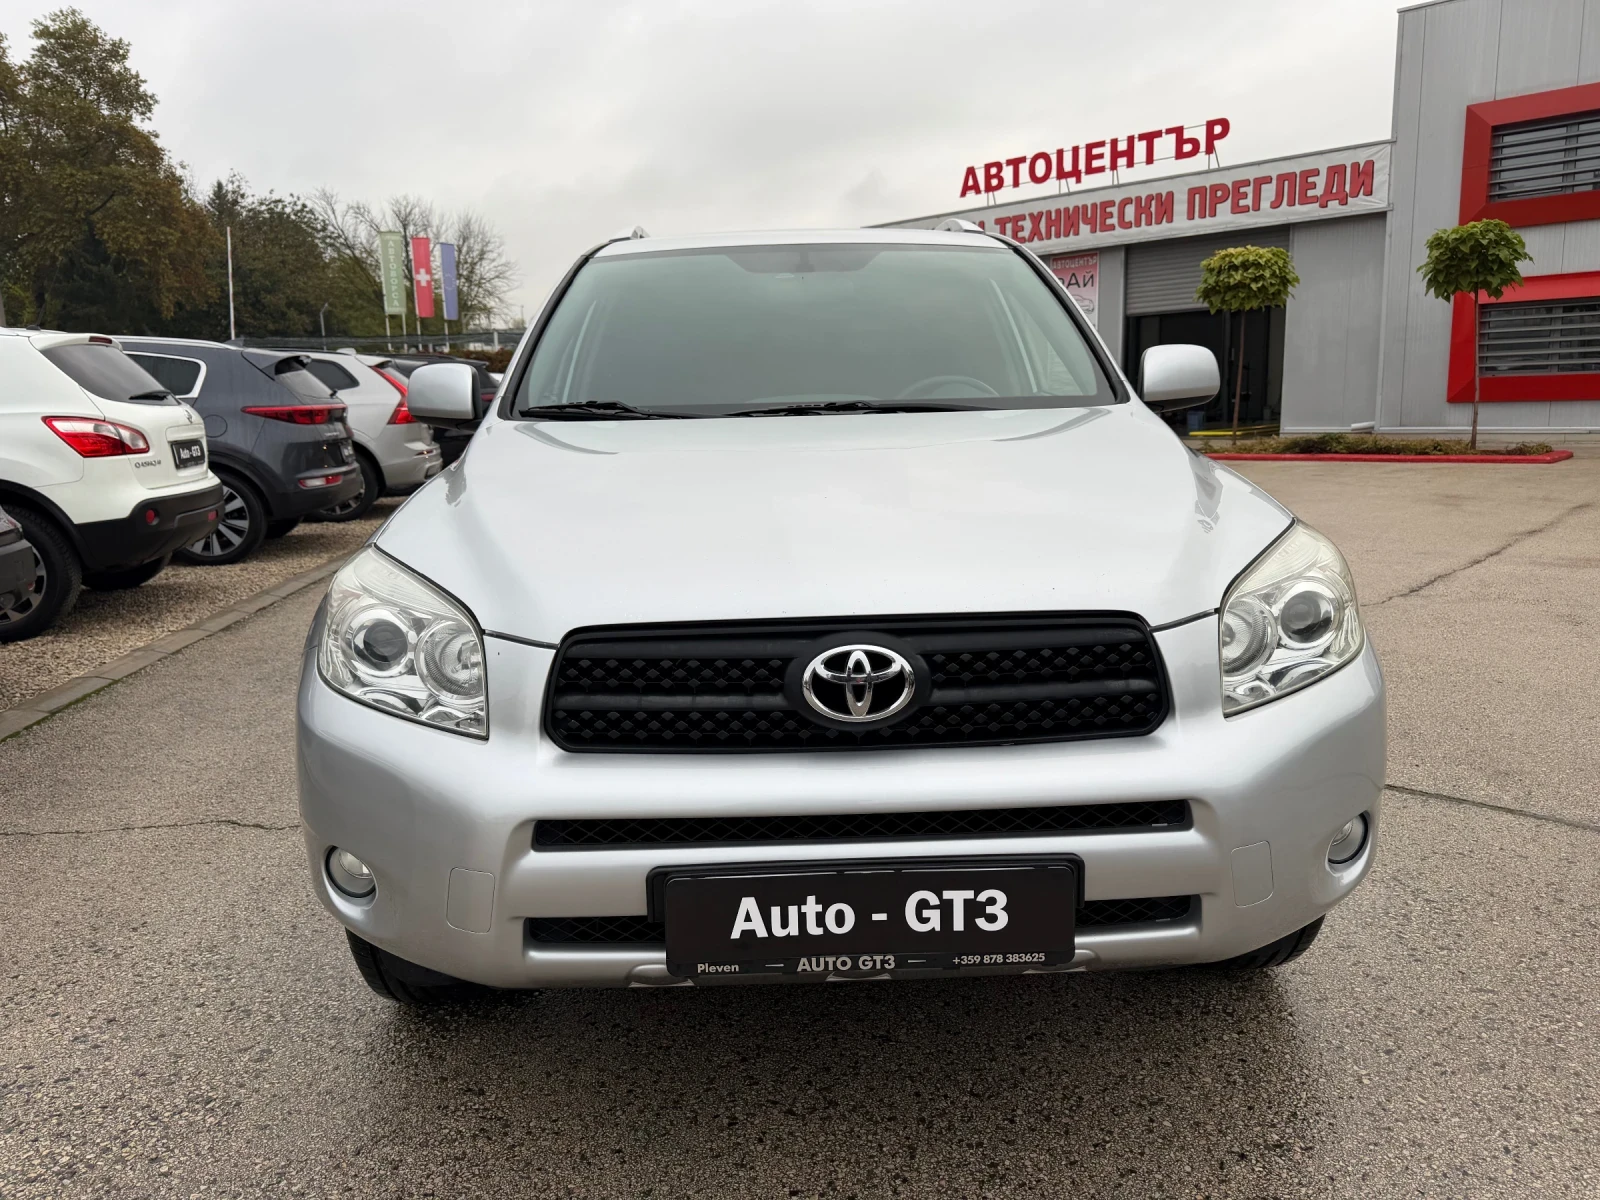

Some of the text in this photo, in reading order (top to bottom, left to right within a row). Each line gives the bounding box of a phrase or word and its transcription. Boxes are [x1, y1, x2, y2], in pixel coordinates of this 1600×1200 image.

[960, 117, 1231, 198] АВТОЦЕНТЪР
[994, 159, 1375, 244] ТЕХНИЧЕСКИ ПРЕГЛЕДИ
[1053, 256, 1098, 269] АВТОЦЕНТЪР
[729, 889, 1009, 939] Auto - GT3
[797, 955, 896, 972] AUTO GT3
[952, 952, 1046, 965] +359 878 383625
[697, 962, 739, 974] Pleven
